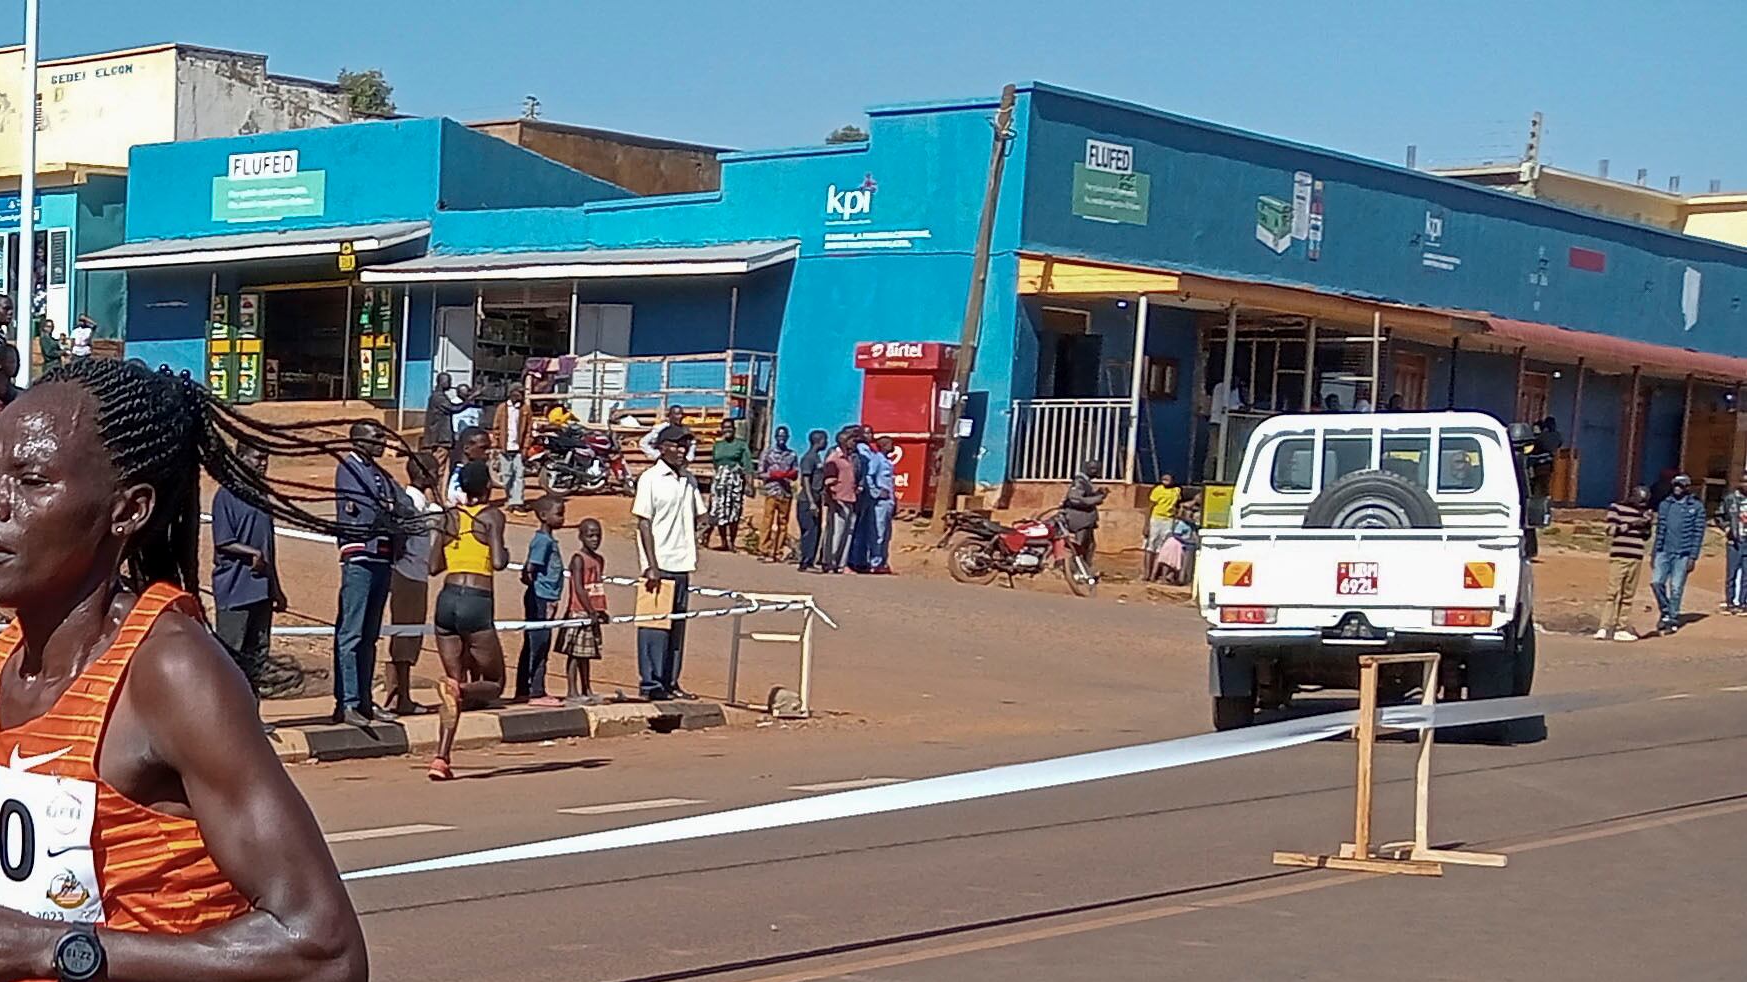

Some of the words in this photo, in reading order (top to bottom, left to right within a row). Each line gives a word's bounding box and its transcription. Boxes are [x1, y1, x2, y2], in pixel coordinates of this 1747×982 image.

[233, 154, 294, 176] FLUFED
[1088, 144, 1130, 171] FLUFED
[826, 184, 871, 221] kpi
